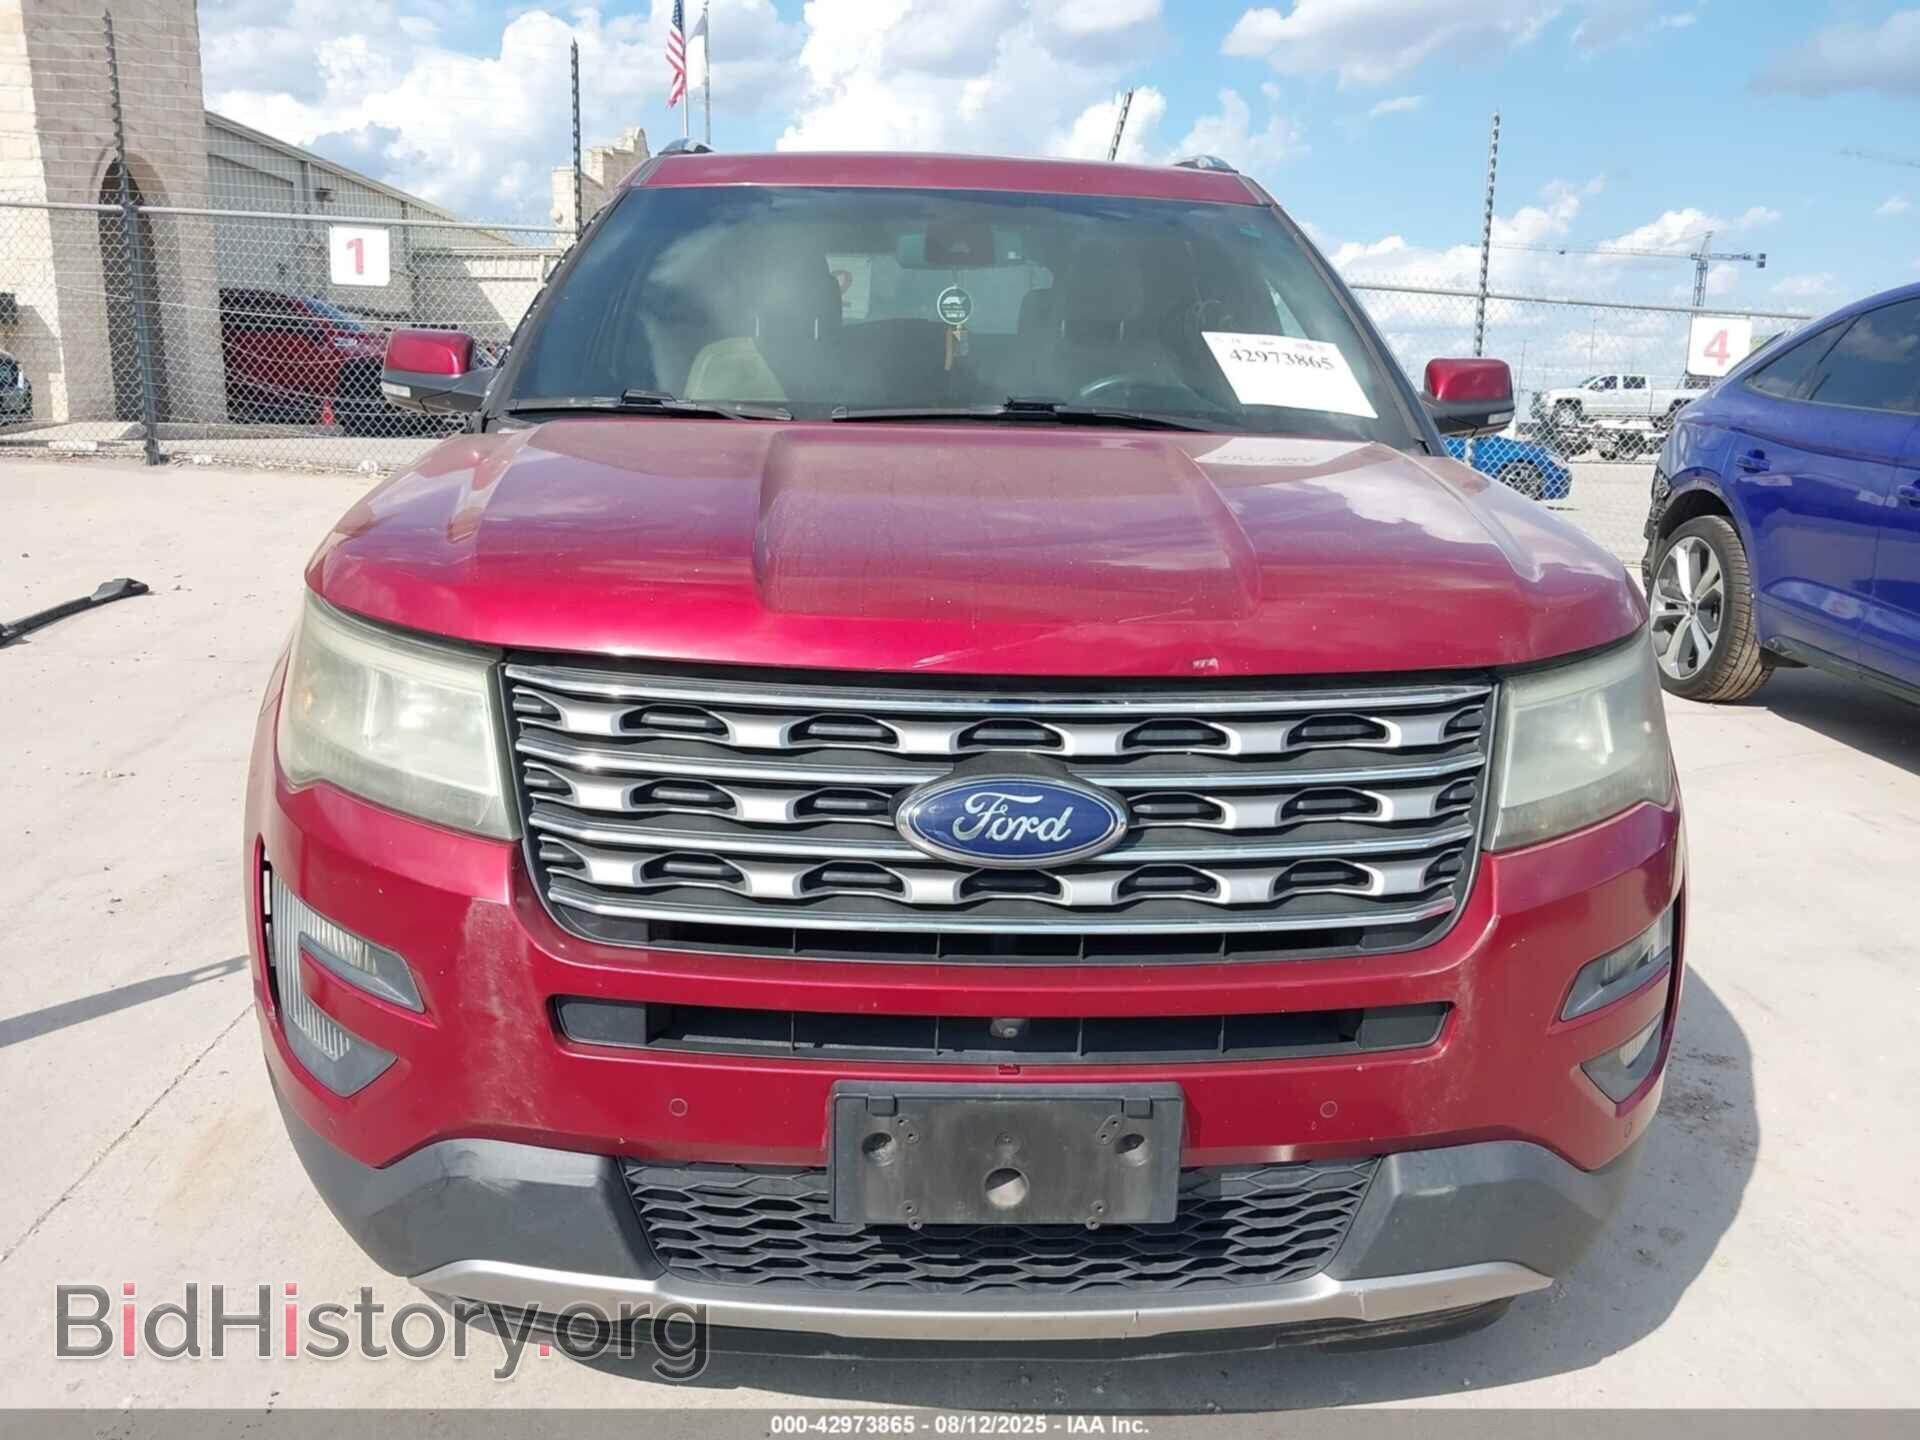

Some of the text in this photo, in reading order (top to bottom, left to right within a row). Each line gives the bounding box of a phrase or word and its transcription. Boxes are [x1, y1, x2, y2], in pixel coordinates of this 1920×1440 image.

[346, 237, 365, 274] 1
[1229, 348, 1335, 370] 42973865
[1702, 328, 1731, 367] 4
[952, 791, 1074, 842] Ford
